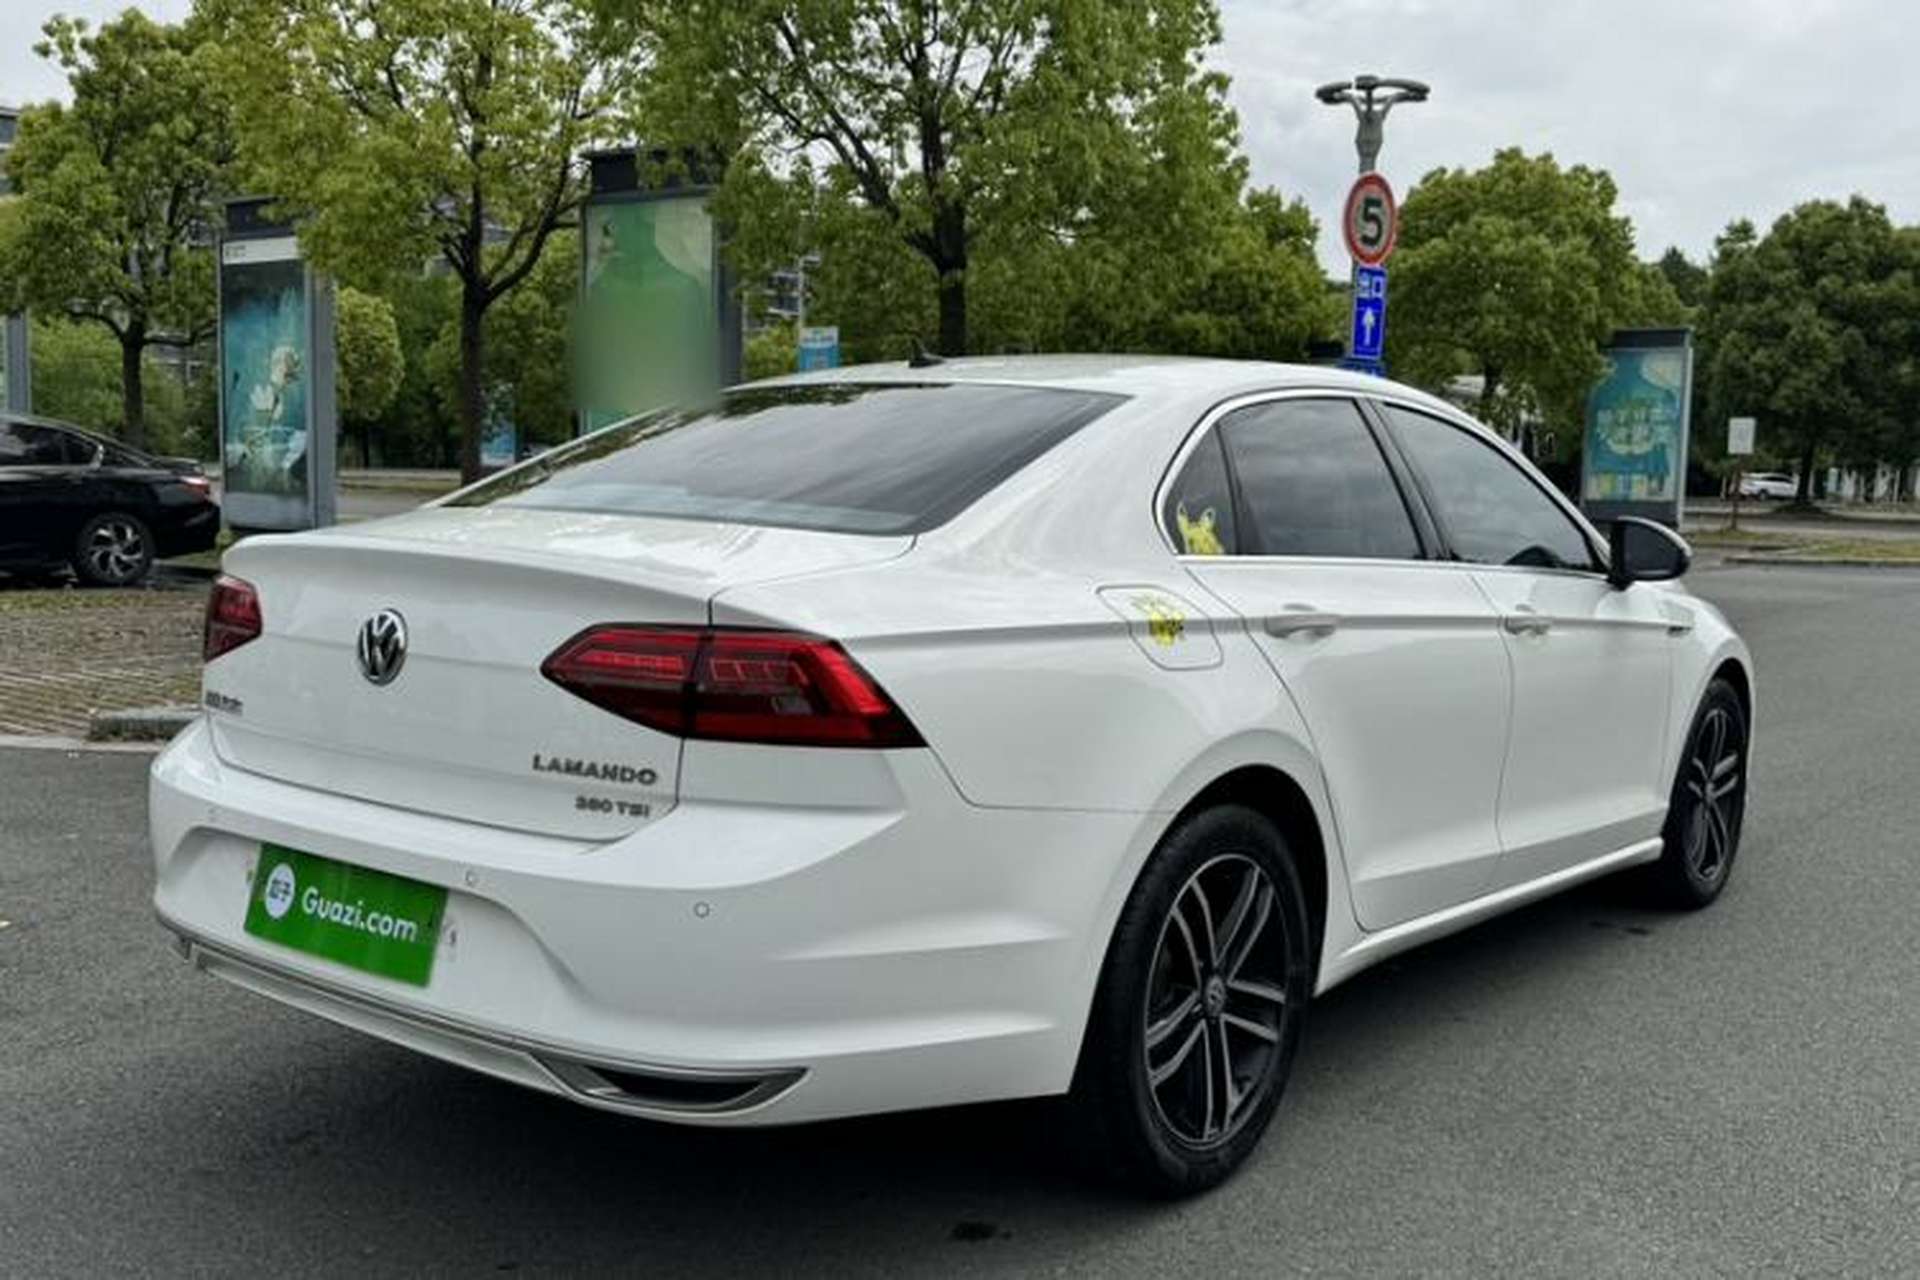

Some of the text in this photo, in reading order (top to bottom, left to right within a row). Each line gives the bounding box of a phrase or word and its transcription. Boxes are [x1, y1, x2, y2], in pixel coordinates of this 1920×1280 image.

[1361, 197, 1382, 247] 5
[532, 753, 657, 785] LAMANDO
[302, 886, 418, 942] Guazi.com
